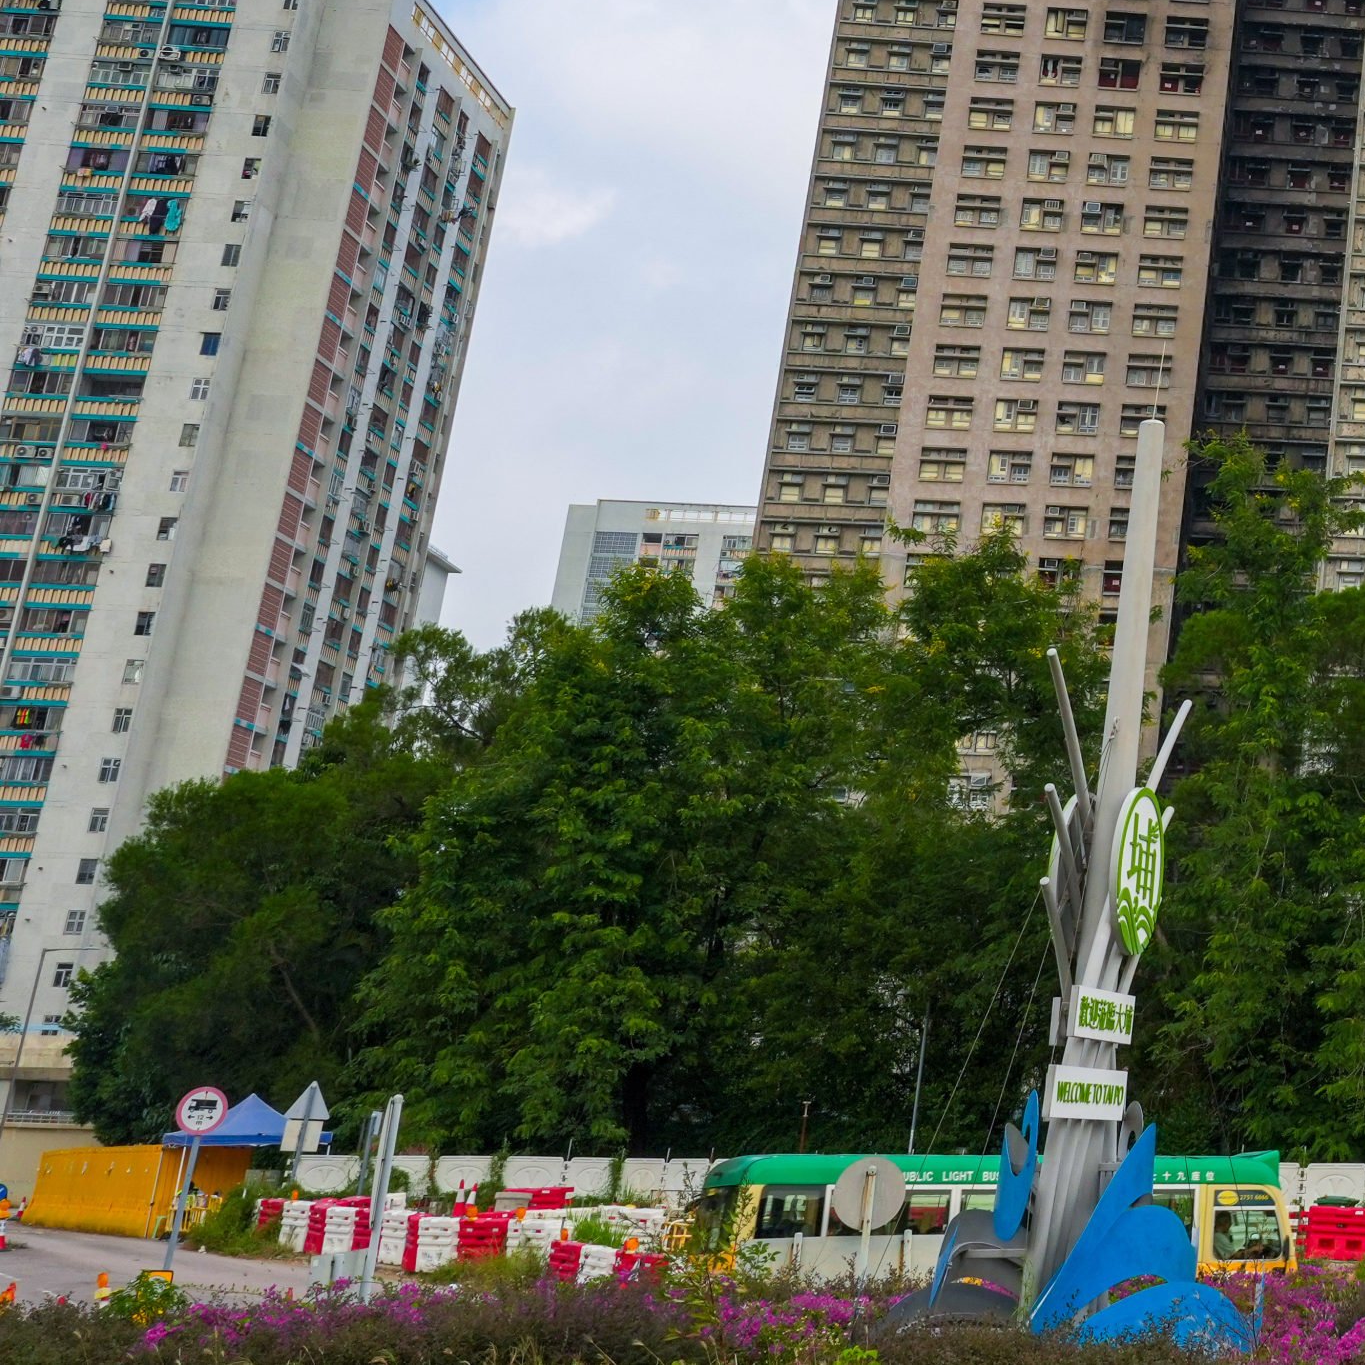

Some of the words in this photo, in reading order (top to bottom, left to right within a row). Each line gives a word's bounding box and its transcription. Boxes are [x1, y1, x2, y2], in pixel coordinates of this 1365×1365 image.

[1056, 1081, 1092, 1104] WELCOME
[1092, 1083, 1103, 1105] TO
[1103, 1084, 1115, 1105] TAI
[1114, 1085, 1125, 1106] PO
[903, 1171, 934, 1182] UBLIC
[942, 1171, 974, 1182] LIGHT
